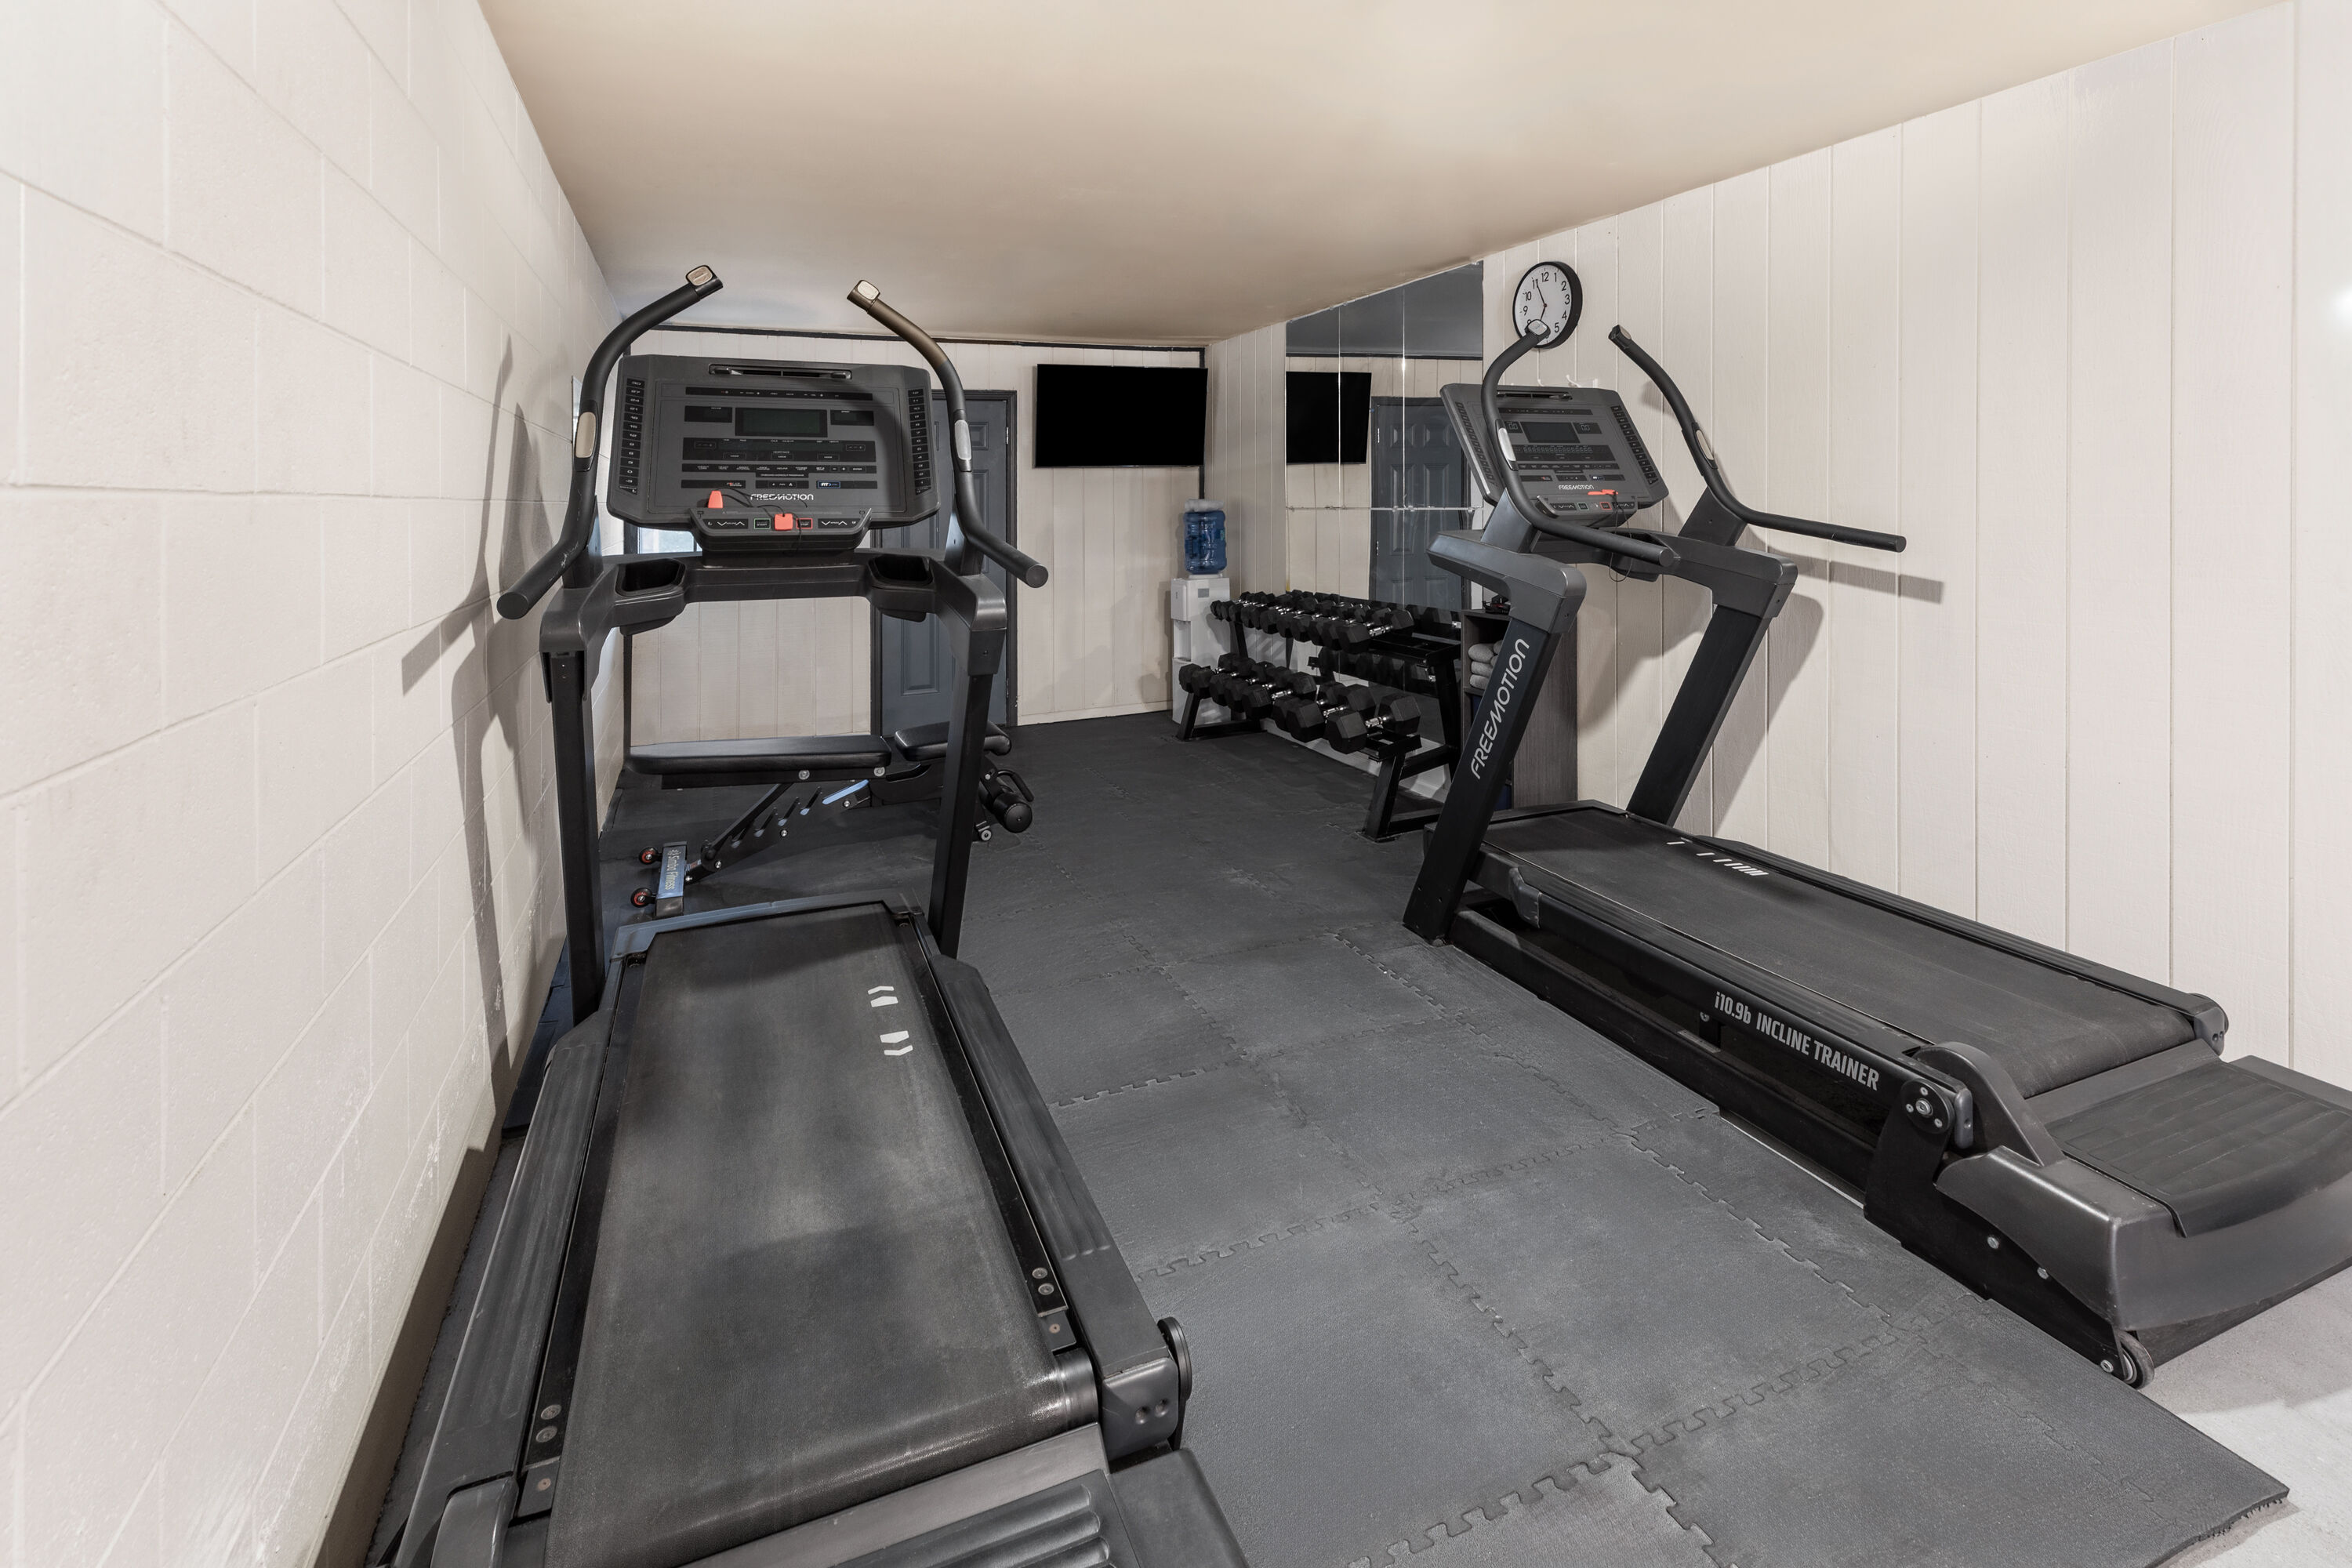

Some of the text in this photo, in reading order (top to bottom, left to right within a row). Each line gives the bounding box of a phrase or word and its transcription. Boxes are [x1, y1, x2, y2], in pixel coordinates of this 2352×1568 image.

[1541, 271, 1549, 283] 12
[1532, 278, 1538, 289] 11
[1561, 281, 1567, 292] 2
[1525, 291, 1532, 302] 10
[1564, 294, 1570, 305] 3
[1523, 305, 1528, 316] 9
[1561, 309, 1567, 321] 4
[1554, 322, 1560, 333] 5
[1471, 638, 1530, 780] FREEMOTION
[665, 871, 678, 891] Fitness
[1714, 991, 1880, 1091] i10.9b INCLINE TRAINER
